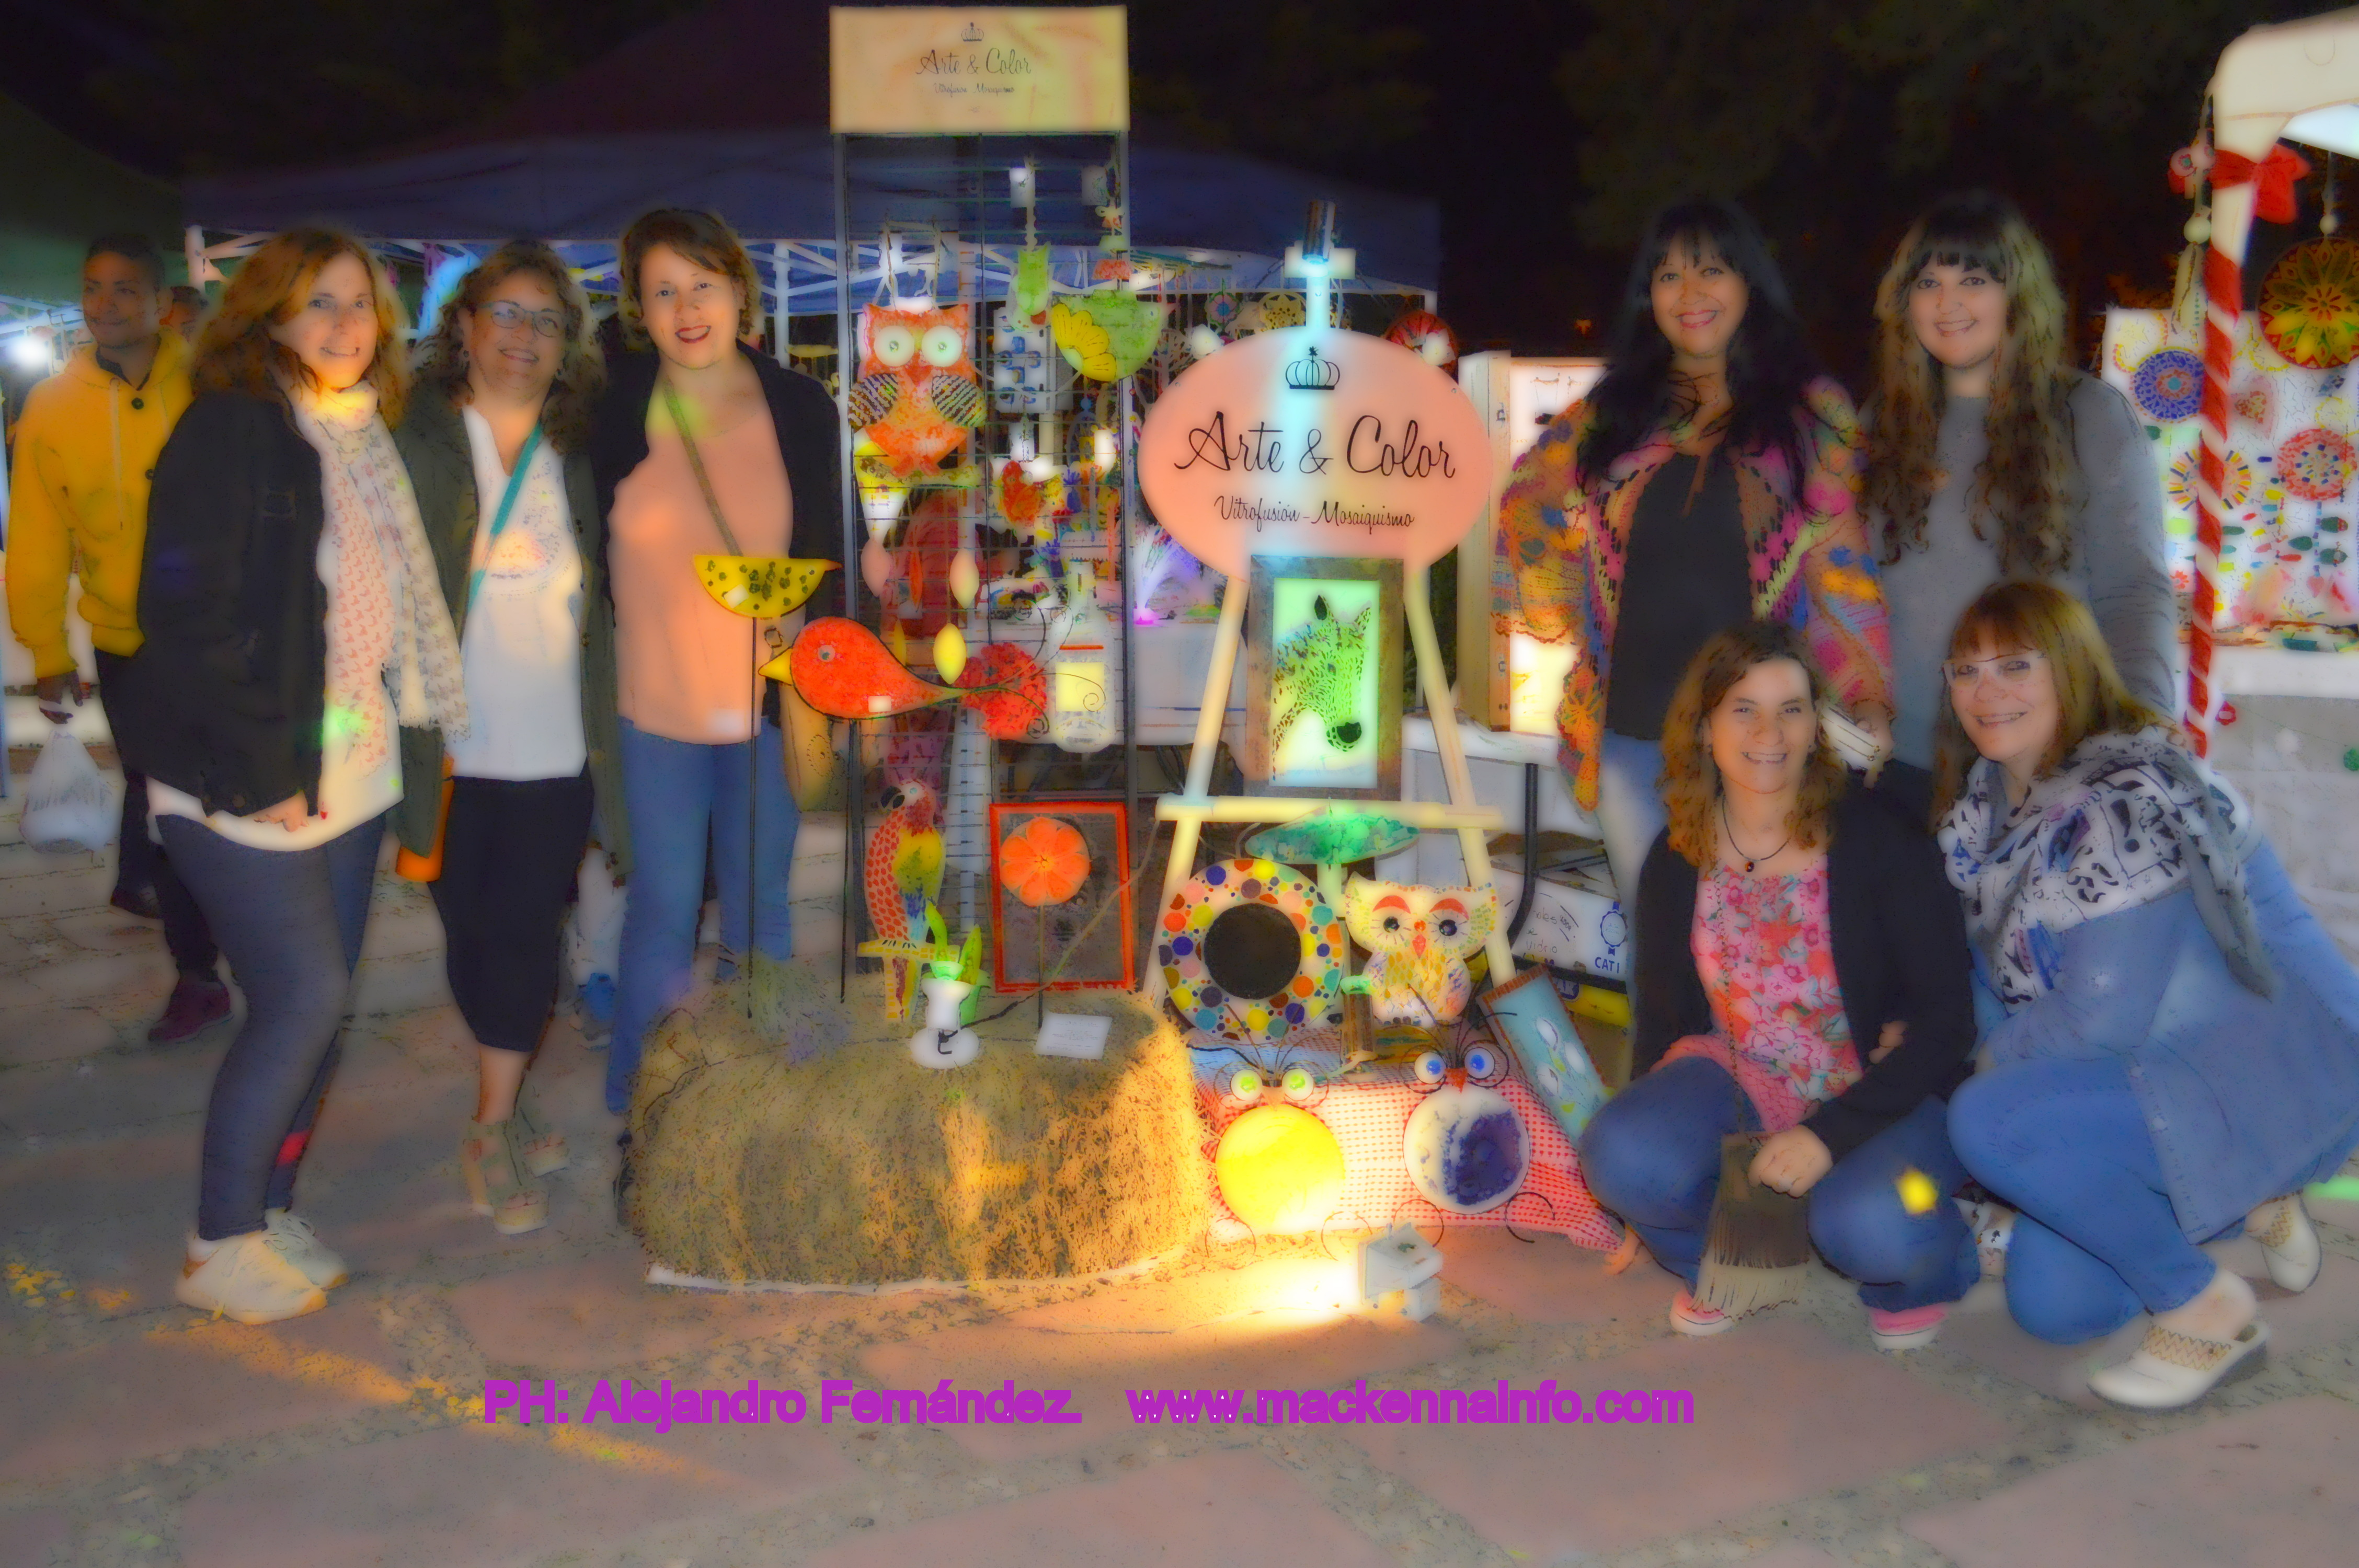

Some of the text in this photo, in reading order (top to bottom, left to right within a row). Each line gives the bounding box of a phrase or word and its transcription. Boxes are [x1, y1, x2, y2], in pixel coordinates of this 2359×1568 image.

[915, 48, 1032, 75] Arte & Color
[1174, 411, 1456, 478] Arte & Color
[1214, 495, 1300, 533] Vitrofusión
[1311, 500, 1415, 535] Mosaiquismo
